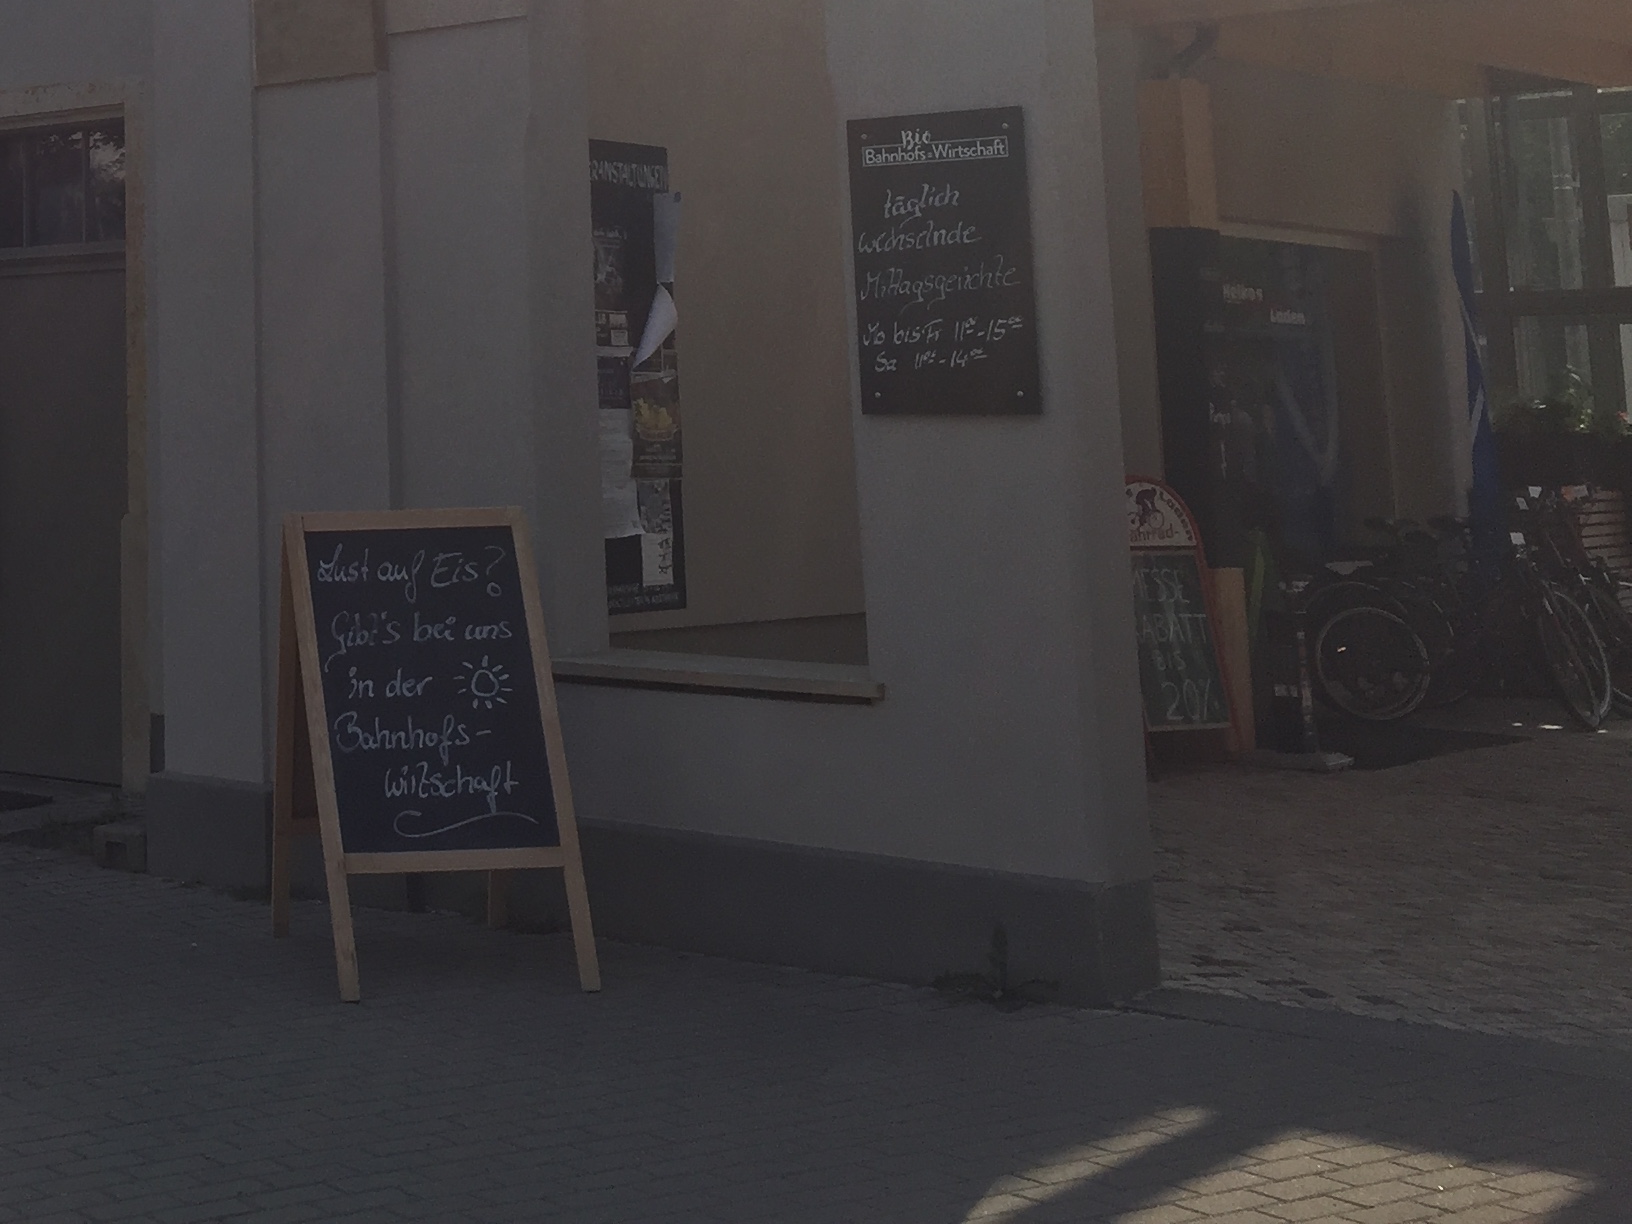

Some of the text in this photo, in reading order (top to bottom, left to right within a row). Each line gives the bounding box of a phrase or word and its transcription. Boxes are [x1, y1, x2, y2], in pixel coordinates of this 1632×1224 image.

[901, 128, 931, 150] Bio
[884, 183, 960, 228] täglich
[893, 321, 920, 344] bis
[875, 351, 897, 372] Sa
[317, 544, 506, 602] Lust auf Eis?
[414, 614, 457, 642] bei
[465, 620, 513, 640] uns
[348, 666, 433, 699] in der
